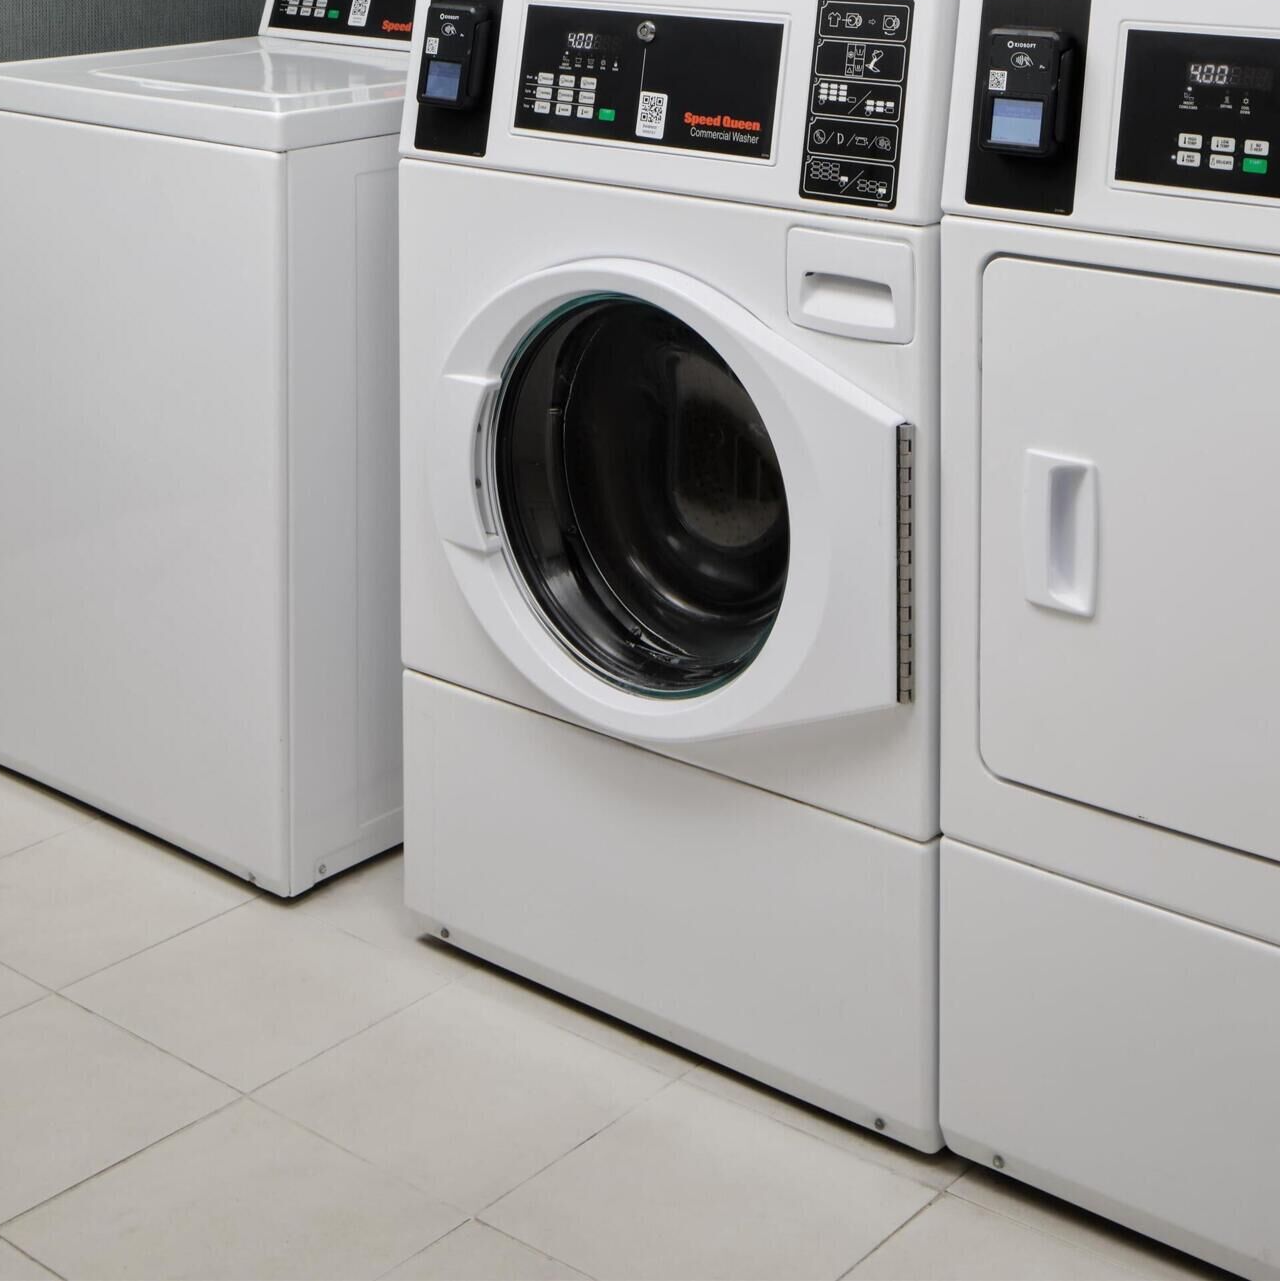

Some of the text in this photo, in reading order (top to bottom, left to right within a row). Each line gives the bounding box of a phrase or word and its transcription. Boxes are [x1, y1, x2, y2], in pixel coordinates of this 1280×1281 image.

[381, 19, 412, 32] Speed
[567, 33, 593, 49] 4.00
[1190, 64, 1229, 85] 4.00
[684, 112, 761, 131] Speed Queen
[690, 127, 759, 144] Commercial Washer
